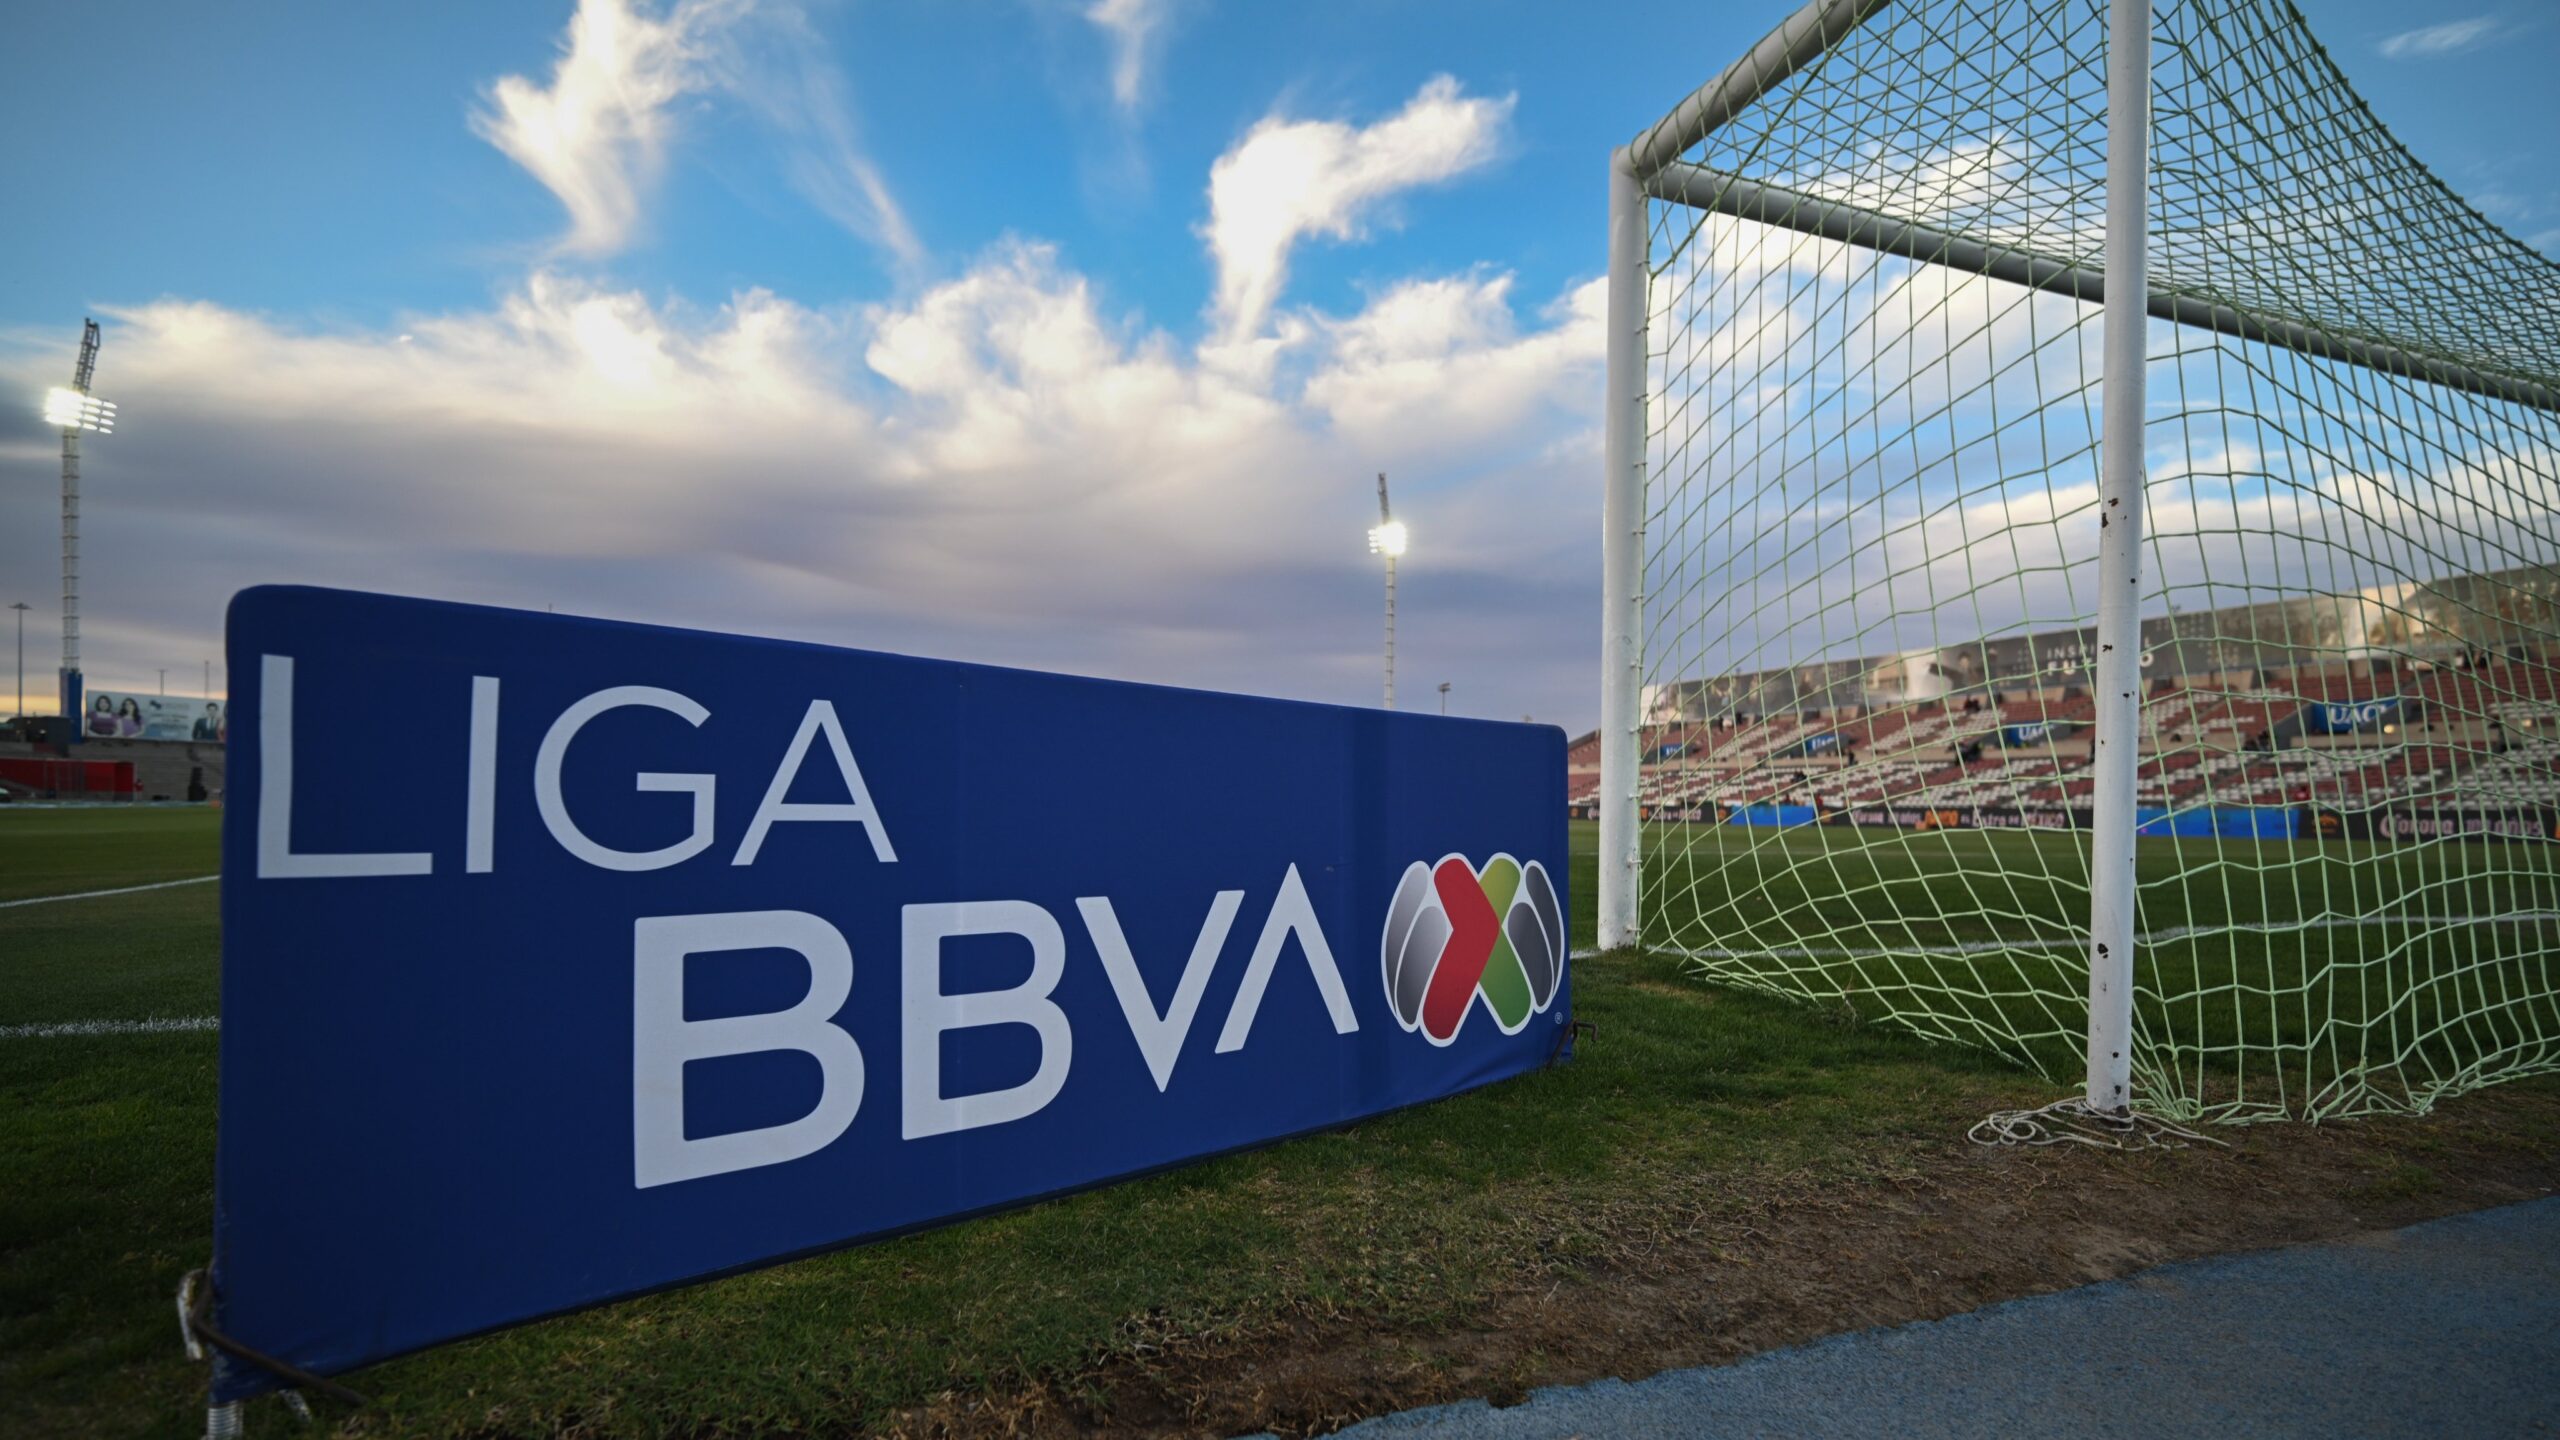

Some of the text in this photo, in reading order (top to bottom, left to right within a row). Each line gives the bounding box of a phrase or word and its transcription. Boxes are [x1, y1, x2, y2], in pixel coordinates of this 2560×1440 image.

[257, 654, 898, 878] LIGA
[2379, 814, 2454, 838] Corona
[634, 862, 1359, 1189] BBVA
